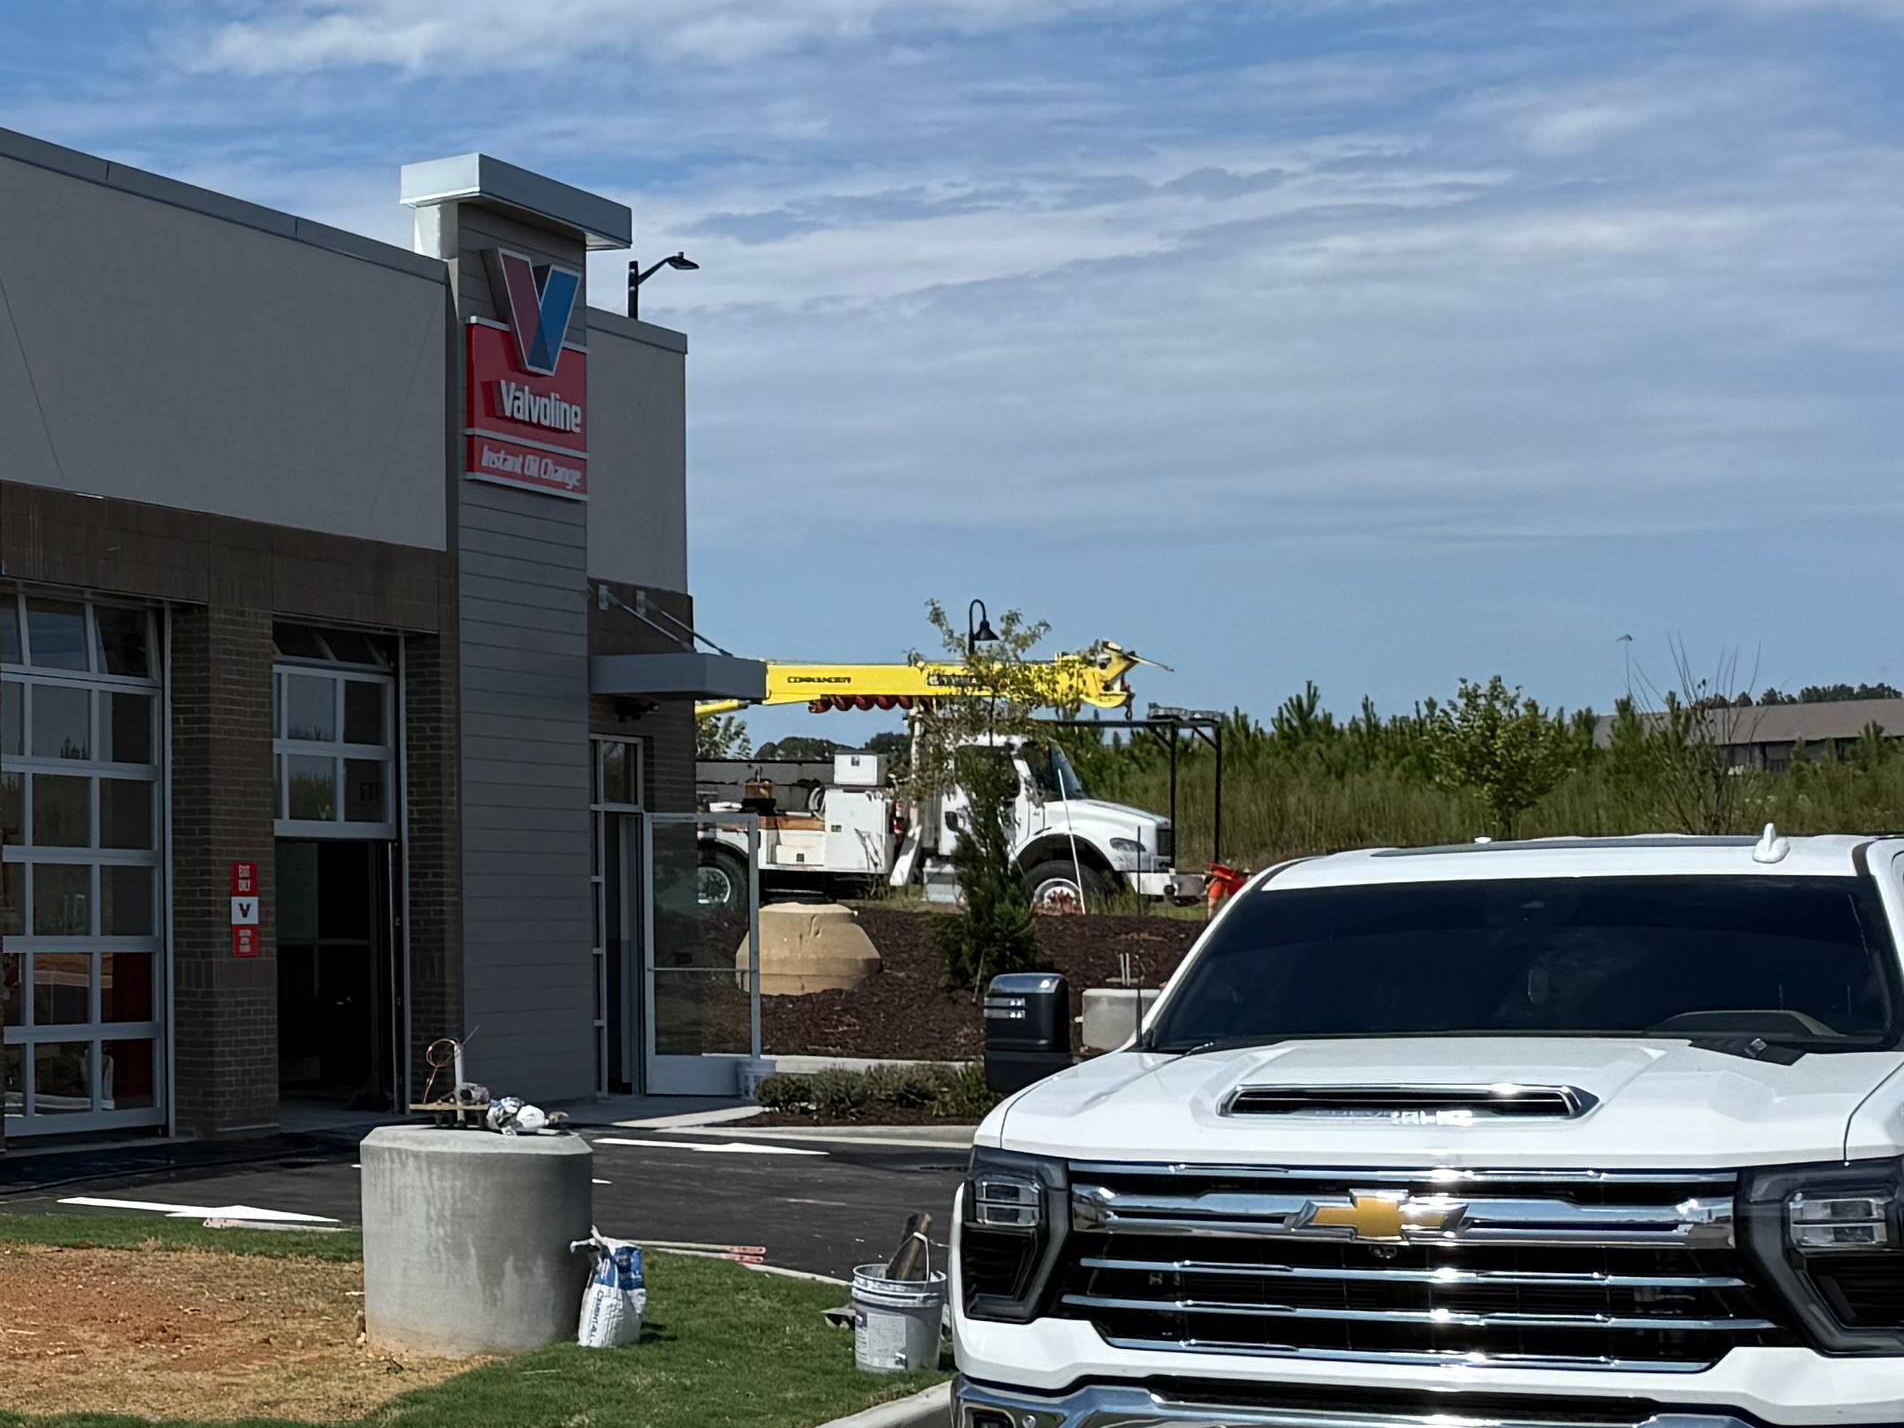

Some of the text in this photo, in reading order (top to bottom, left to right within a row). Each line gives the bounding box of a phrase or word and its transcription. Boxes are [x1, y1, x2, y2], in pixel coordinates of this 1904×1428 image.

[500, 379, 582, 433] Valvoline
[481, 444, 582, 489] Instant Oil Change
